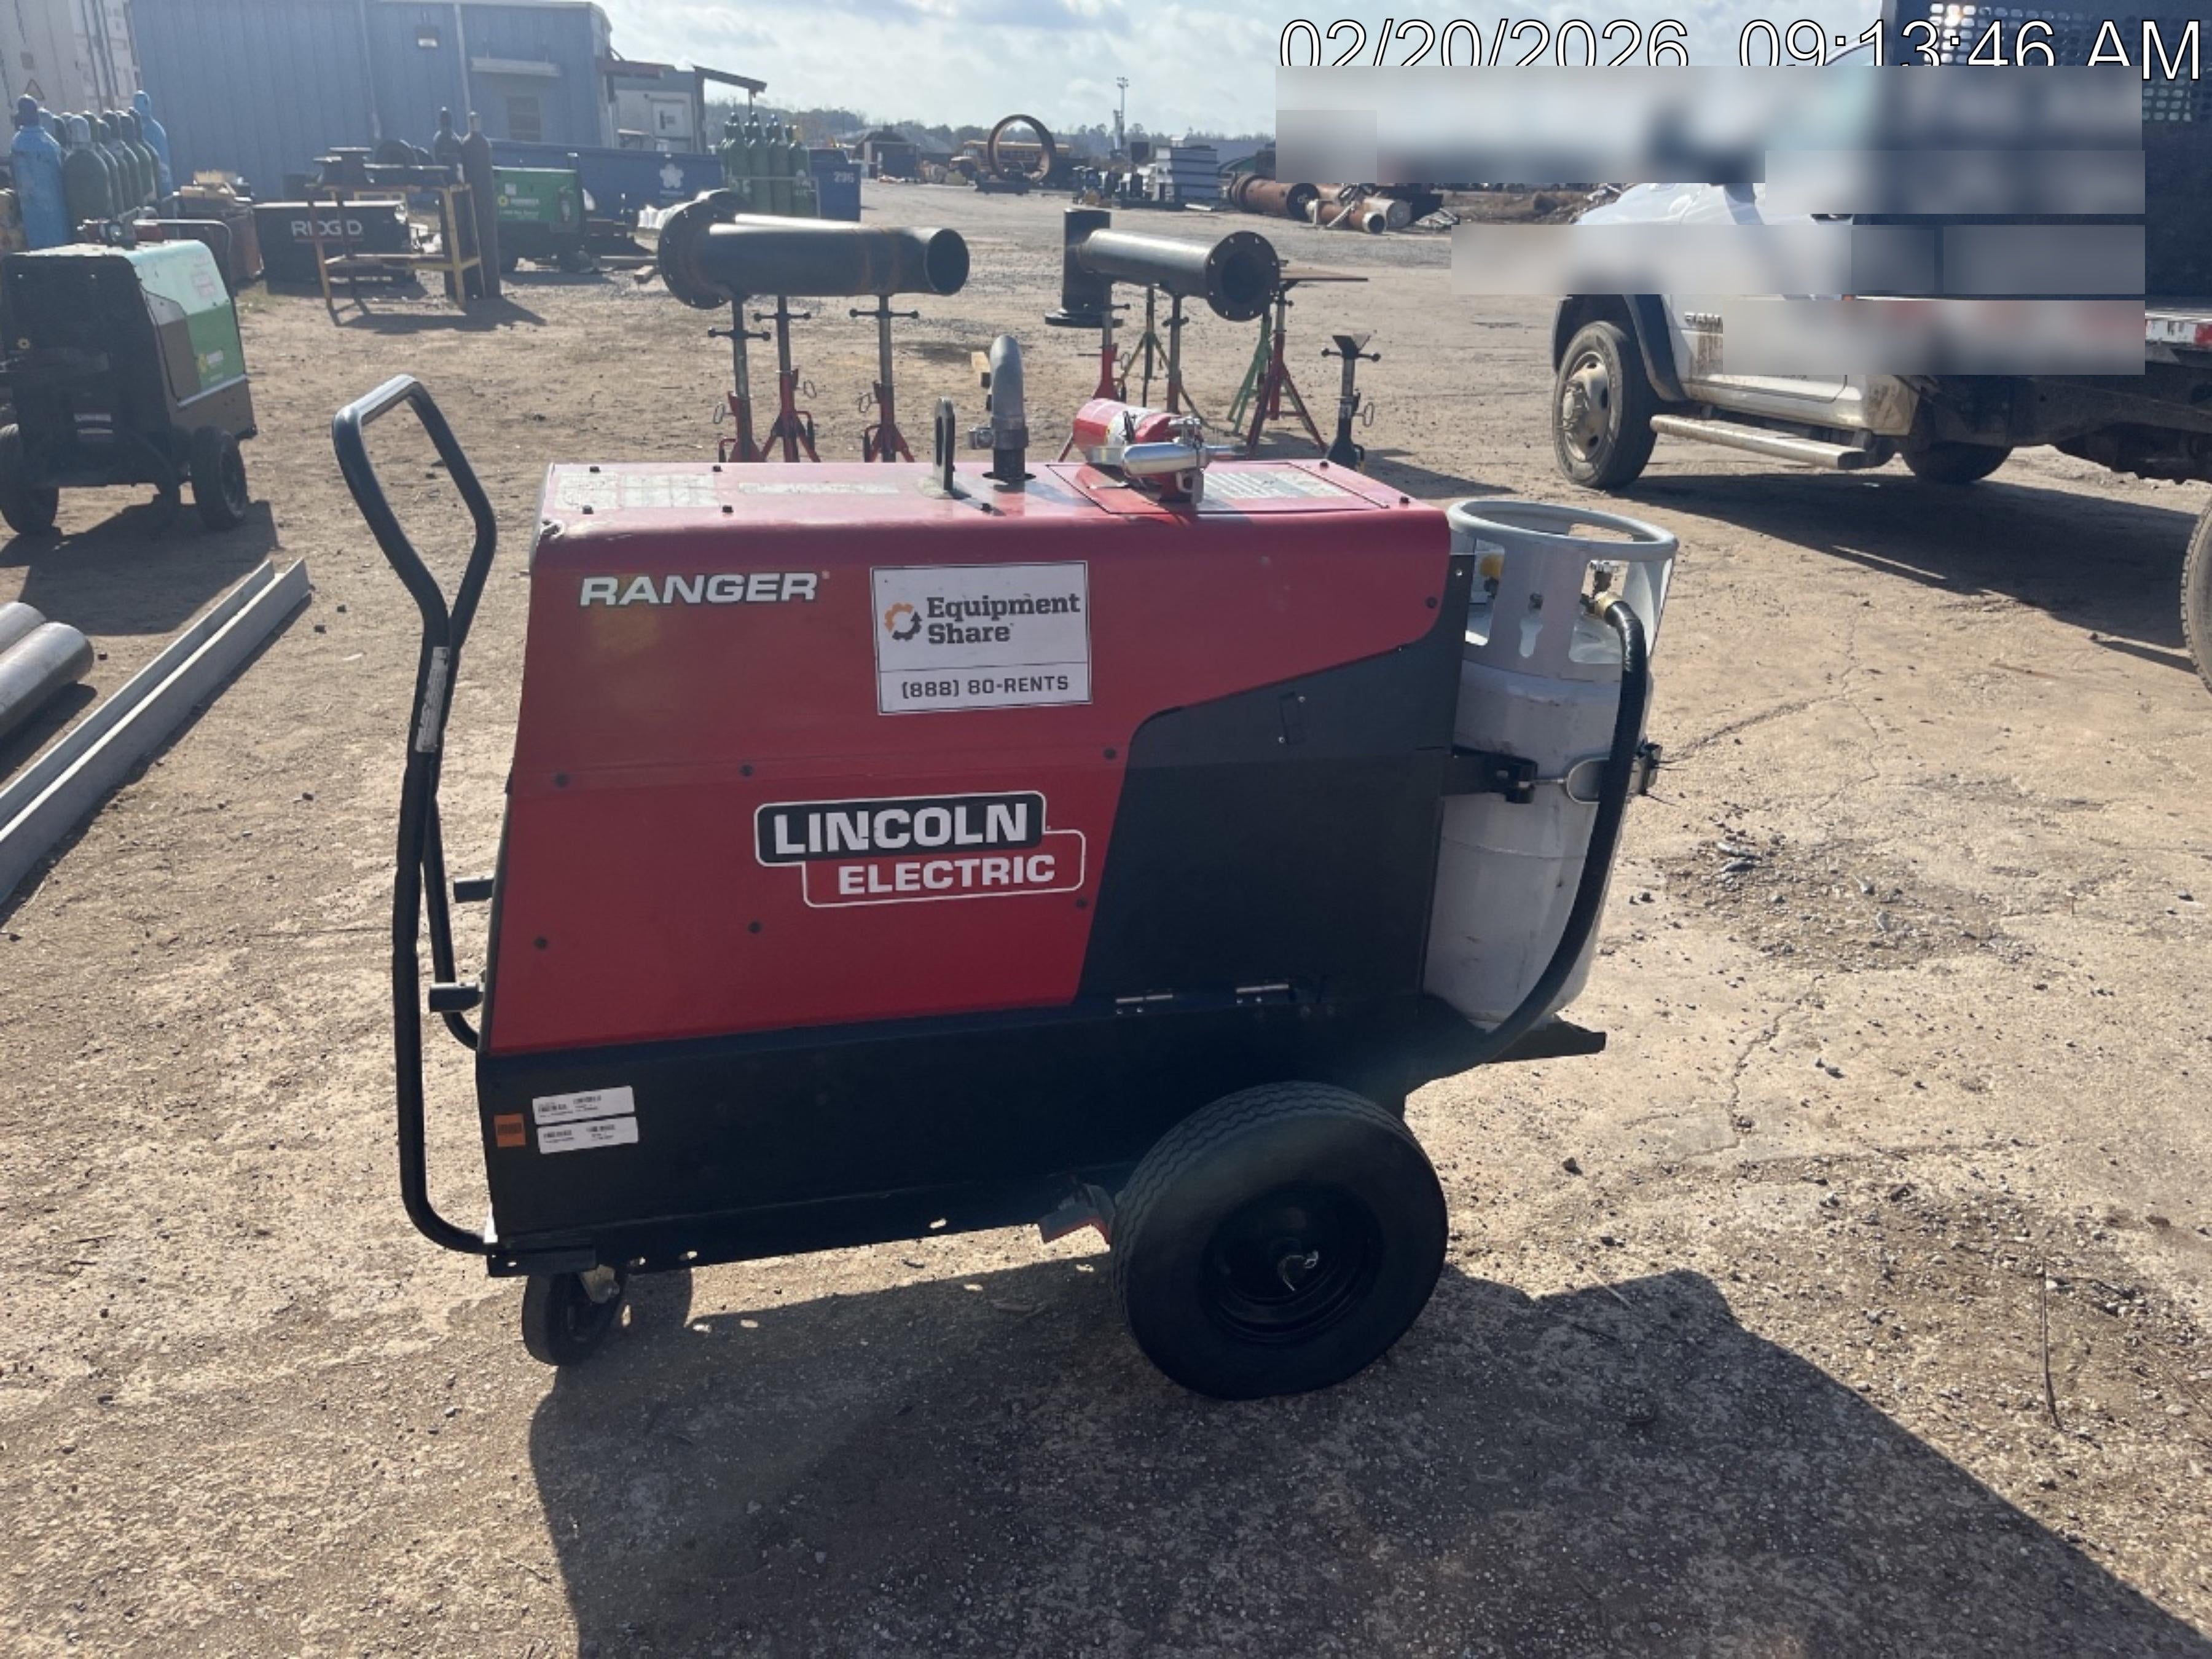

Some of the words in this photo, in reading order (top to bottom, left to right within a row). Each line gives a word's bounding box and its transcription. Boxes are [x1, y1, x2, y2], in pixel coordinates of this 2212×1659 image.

[291, 219, 363, 237] RIDGD
[580, 573, 818, 606] RANGER
[927, 593, 1081, 622] Equipment
[928, 623, 1011, 645] Share
[901, 680, 960, 699] (888)
[967, 676, 1069, 696] 80-RENTS
[774, 802, 1027, 855] LINCOLN
[838, 855, 1056, 895] ELECTRIC
